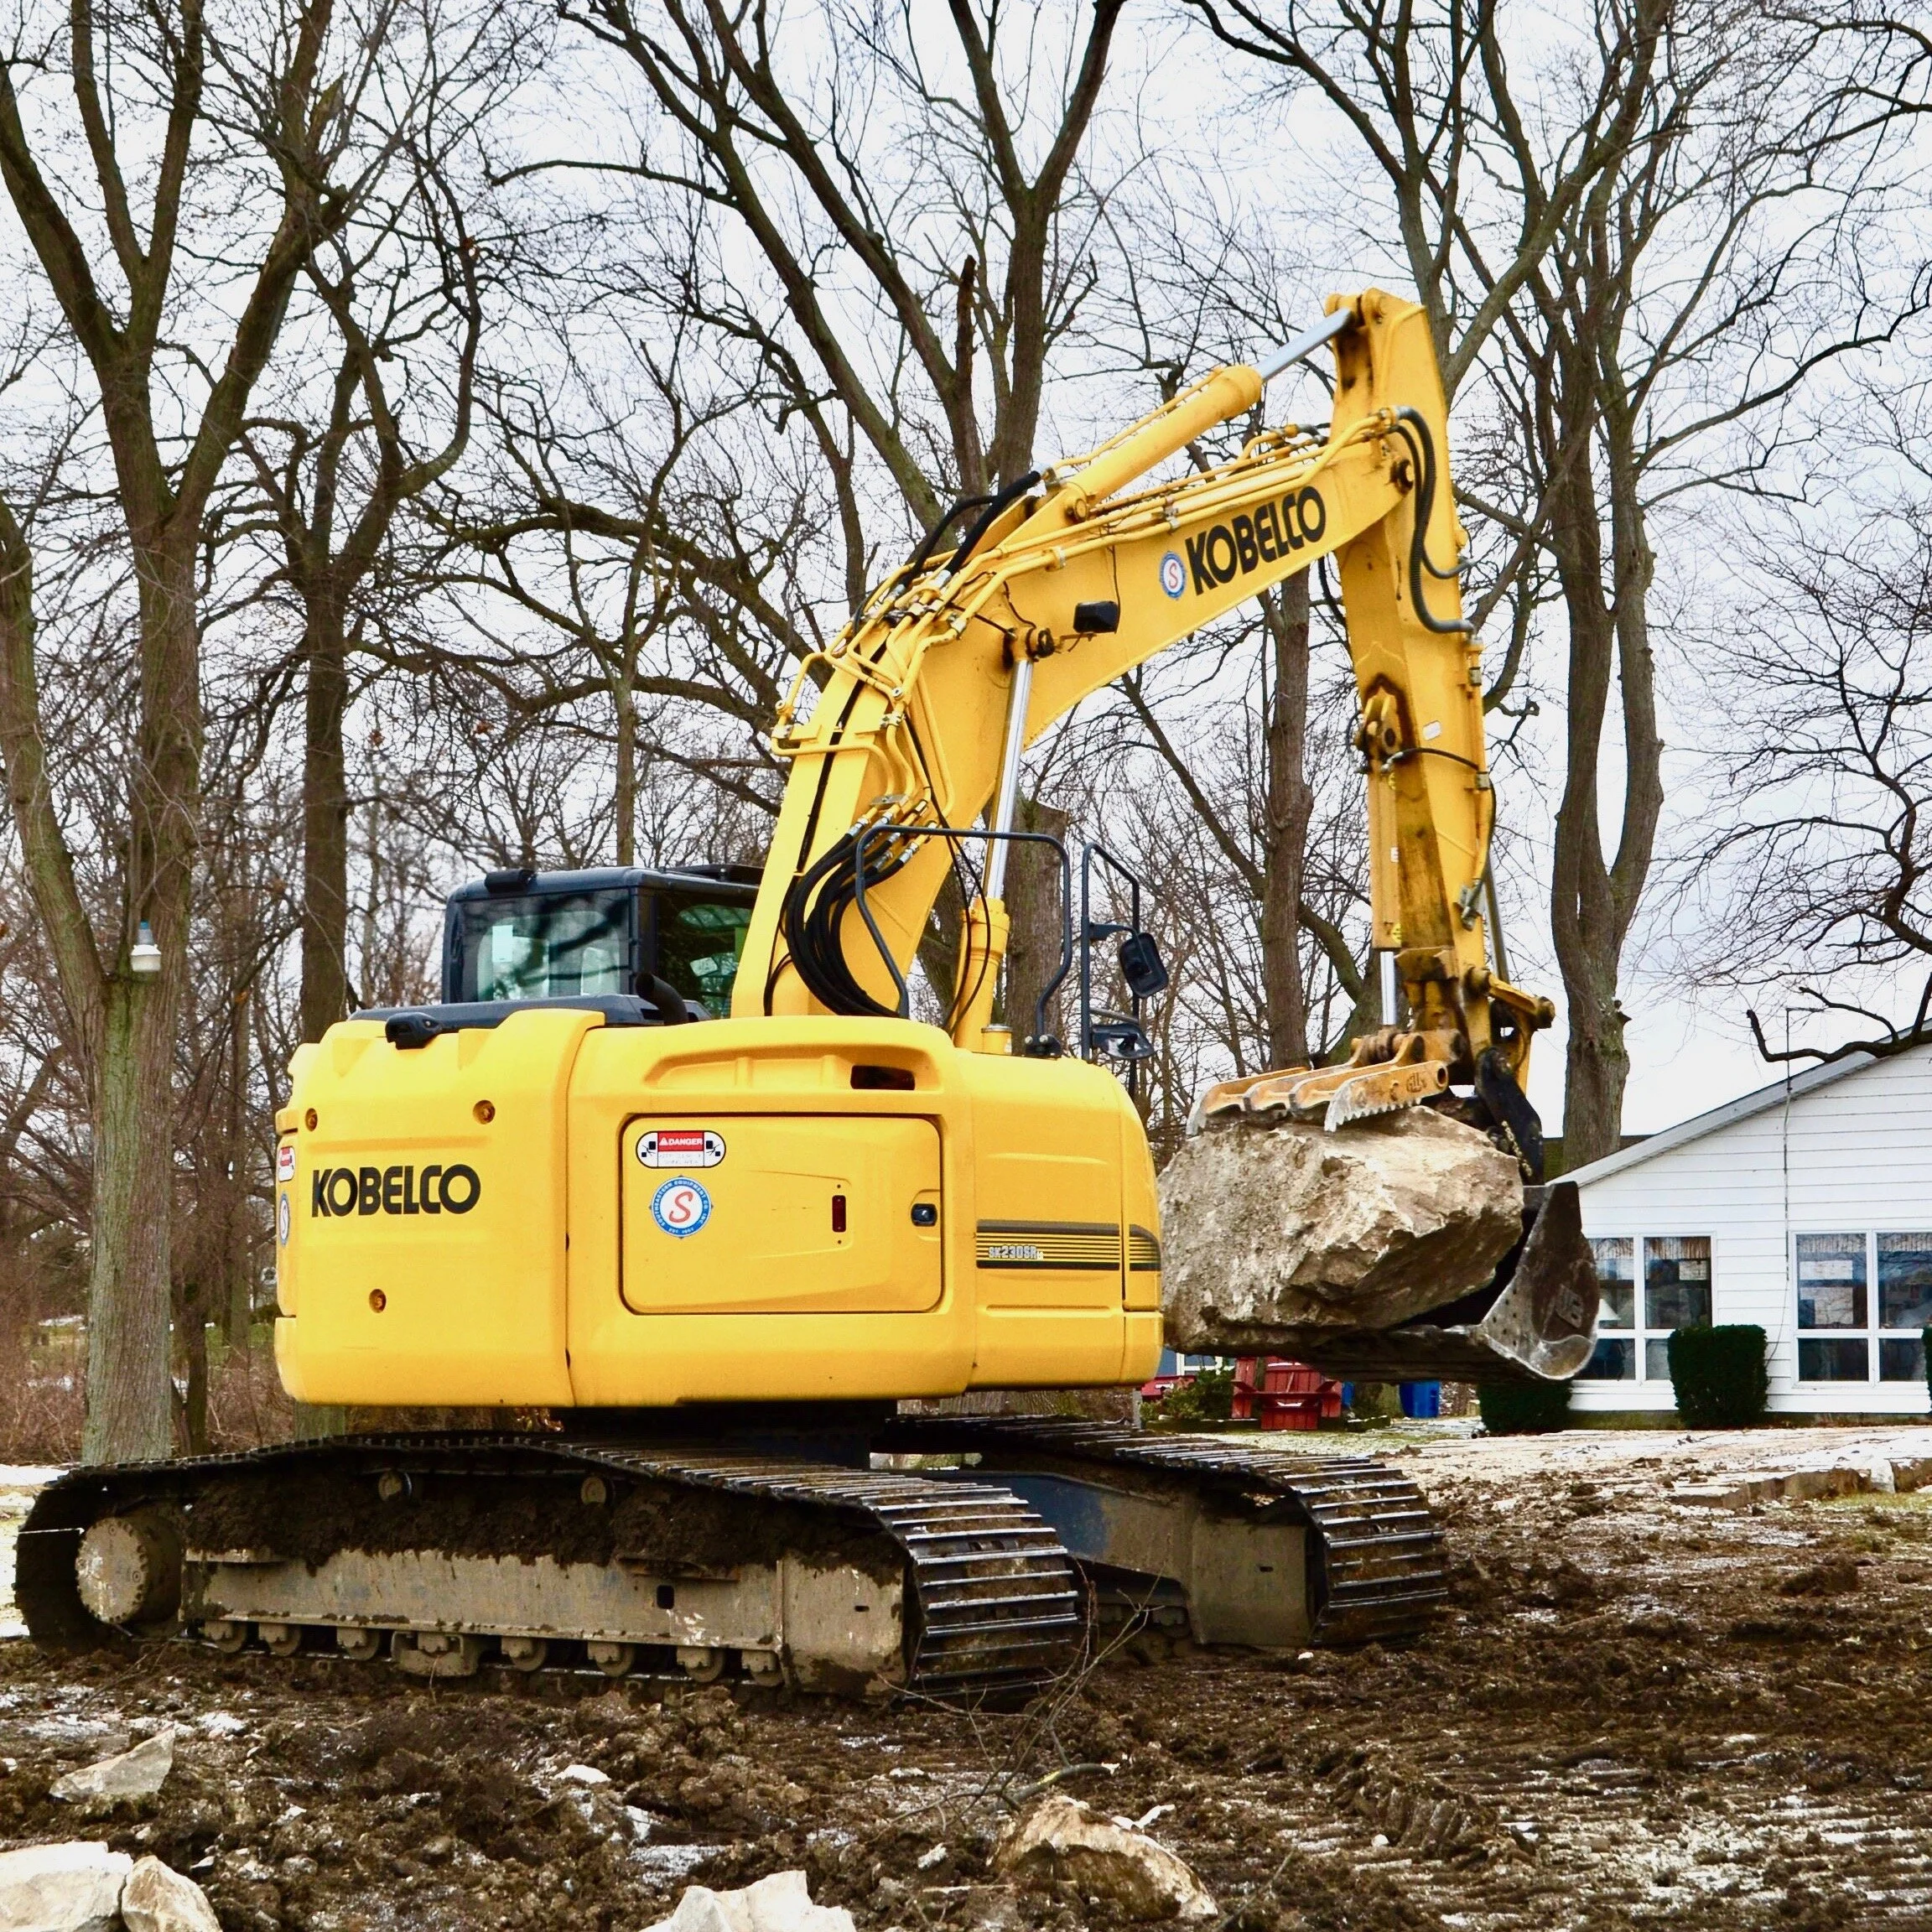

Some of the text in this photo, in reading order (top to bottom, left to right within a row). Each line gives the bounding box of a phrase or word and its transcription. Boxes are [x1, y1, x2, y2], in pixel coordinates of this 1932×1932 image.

[1185, 486, 1326, 596] KOBELCO
[668, 1138, 703, 1146] DANGER
[311, 1164, 481, 1218] KOBELCO
[668, 1191, 693, 1223] S
